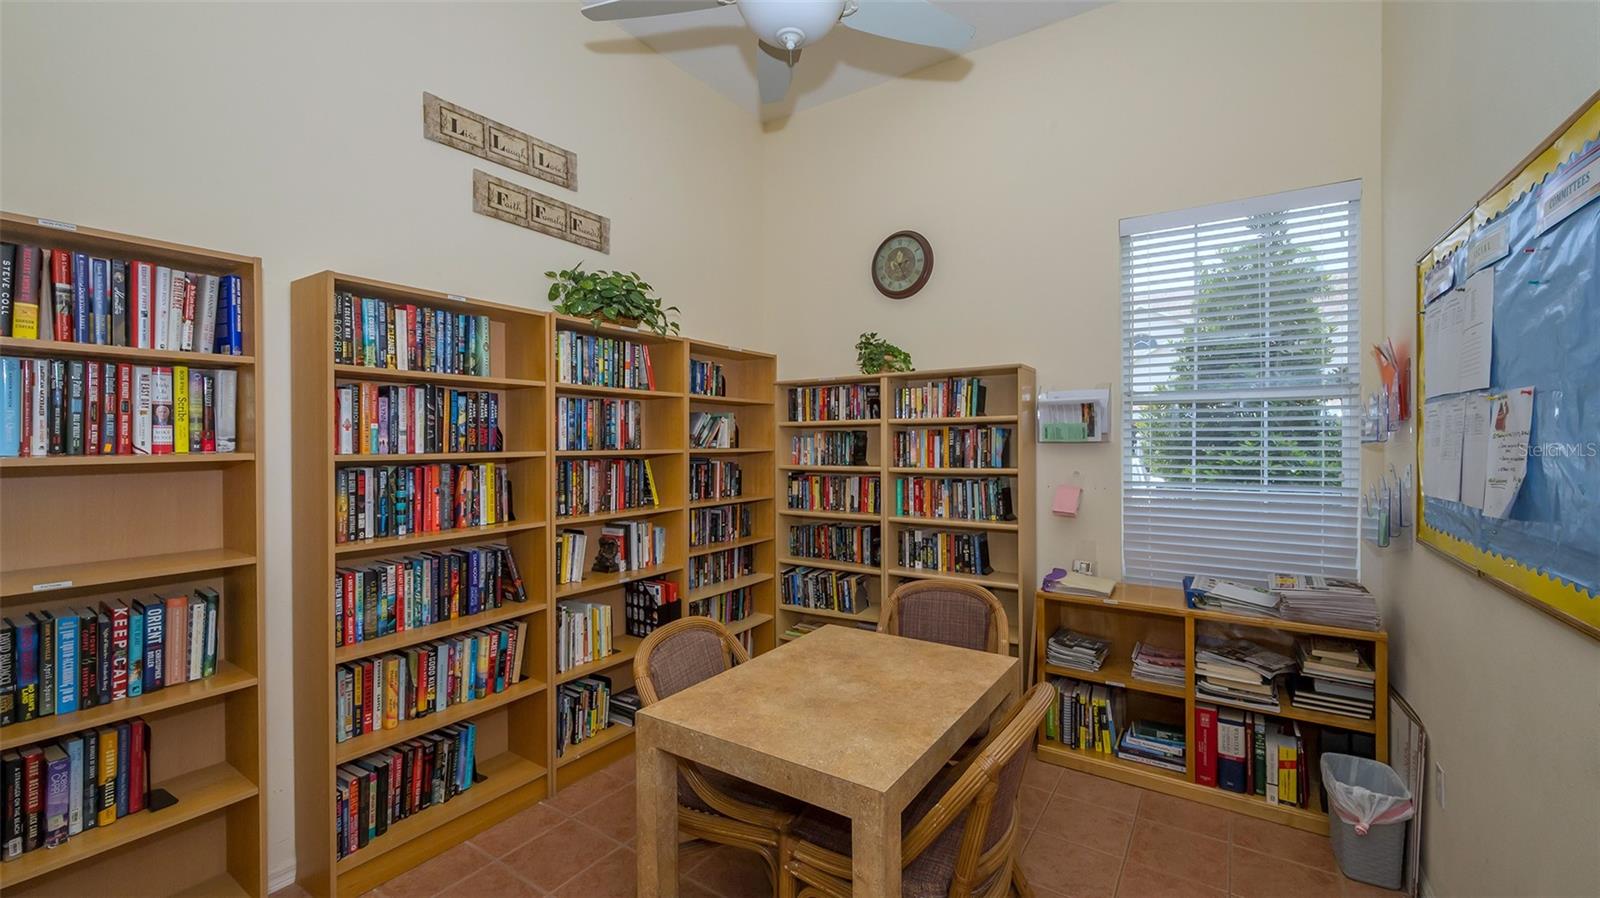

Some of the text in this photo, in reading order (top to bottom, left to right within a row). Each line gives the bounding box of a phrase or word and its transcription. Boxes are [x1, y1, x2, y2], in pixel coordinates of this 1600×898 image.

[450, 117, 478, 141] Live
[495, 191, 522, 213] Faith
[1548, 170, 1591, 209] COMMITTEES
[1, 260, 11, 316] STEVE COLL
[173, 277, 184, 310] RESILIENCE
[334, 319, 342, 352] BOX 88
[72, 363, 82, 398] Killing Patton
[142, 374, 151, 410] NO EASY DAY
[177, 397, 187, 422] Scribe
[147, 608, 162, 644] ORIENT
[0, 631, 12, 653] DAVID
[113, 607, 128, 701] KEEP CALM
[490, 634, 498, 658] MACBETH
[0, 653, 12, 686] BALDACCI
[154, 649, 162, 680] CHRISTOPHER
[428, 656, 436, 676] GOOD
[44, 663, 52, 701] April Spain
[428, 677, 436, 692] KILL
[14, 772, 22, 798] STRANGER
[29, 760, 39, 808] TRUE BELIEVER
[104, 781, 115, 808] KILLERS
[14, 798, 22, 806] ON
[14, 806, 22, 818] THE
